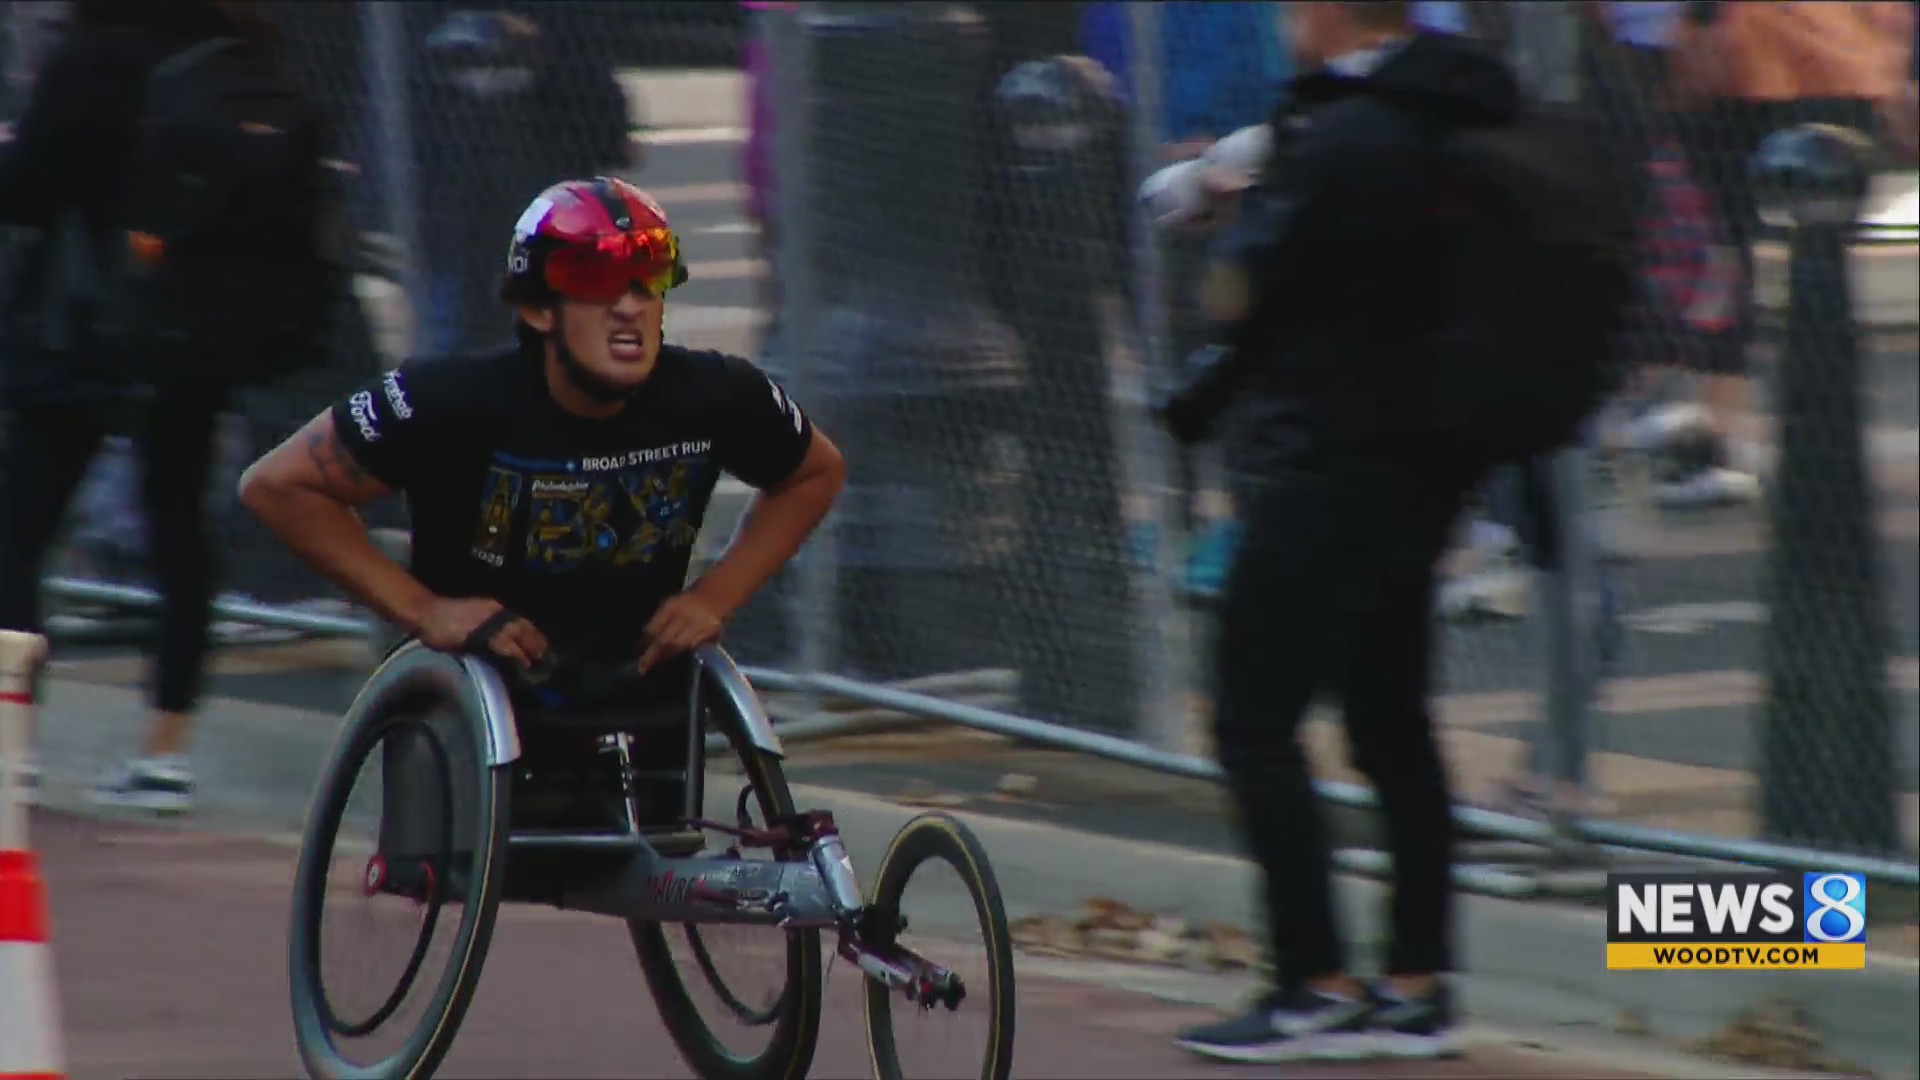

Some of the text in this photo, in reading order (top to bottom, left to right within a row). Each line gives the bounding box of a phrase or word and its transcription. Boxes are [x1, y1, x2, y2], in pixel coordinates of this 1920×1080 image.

[349, 390, 381, 441] Ford
[582, 455, 626, 471] BROAD
[628, 443, 679, 466] STREET
[681, 439, 712, 455] RUN
